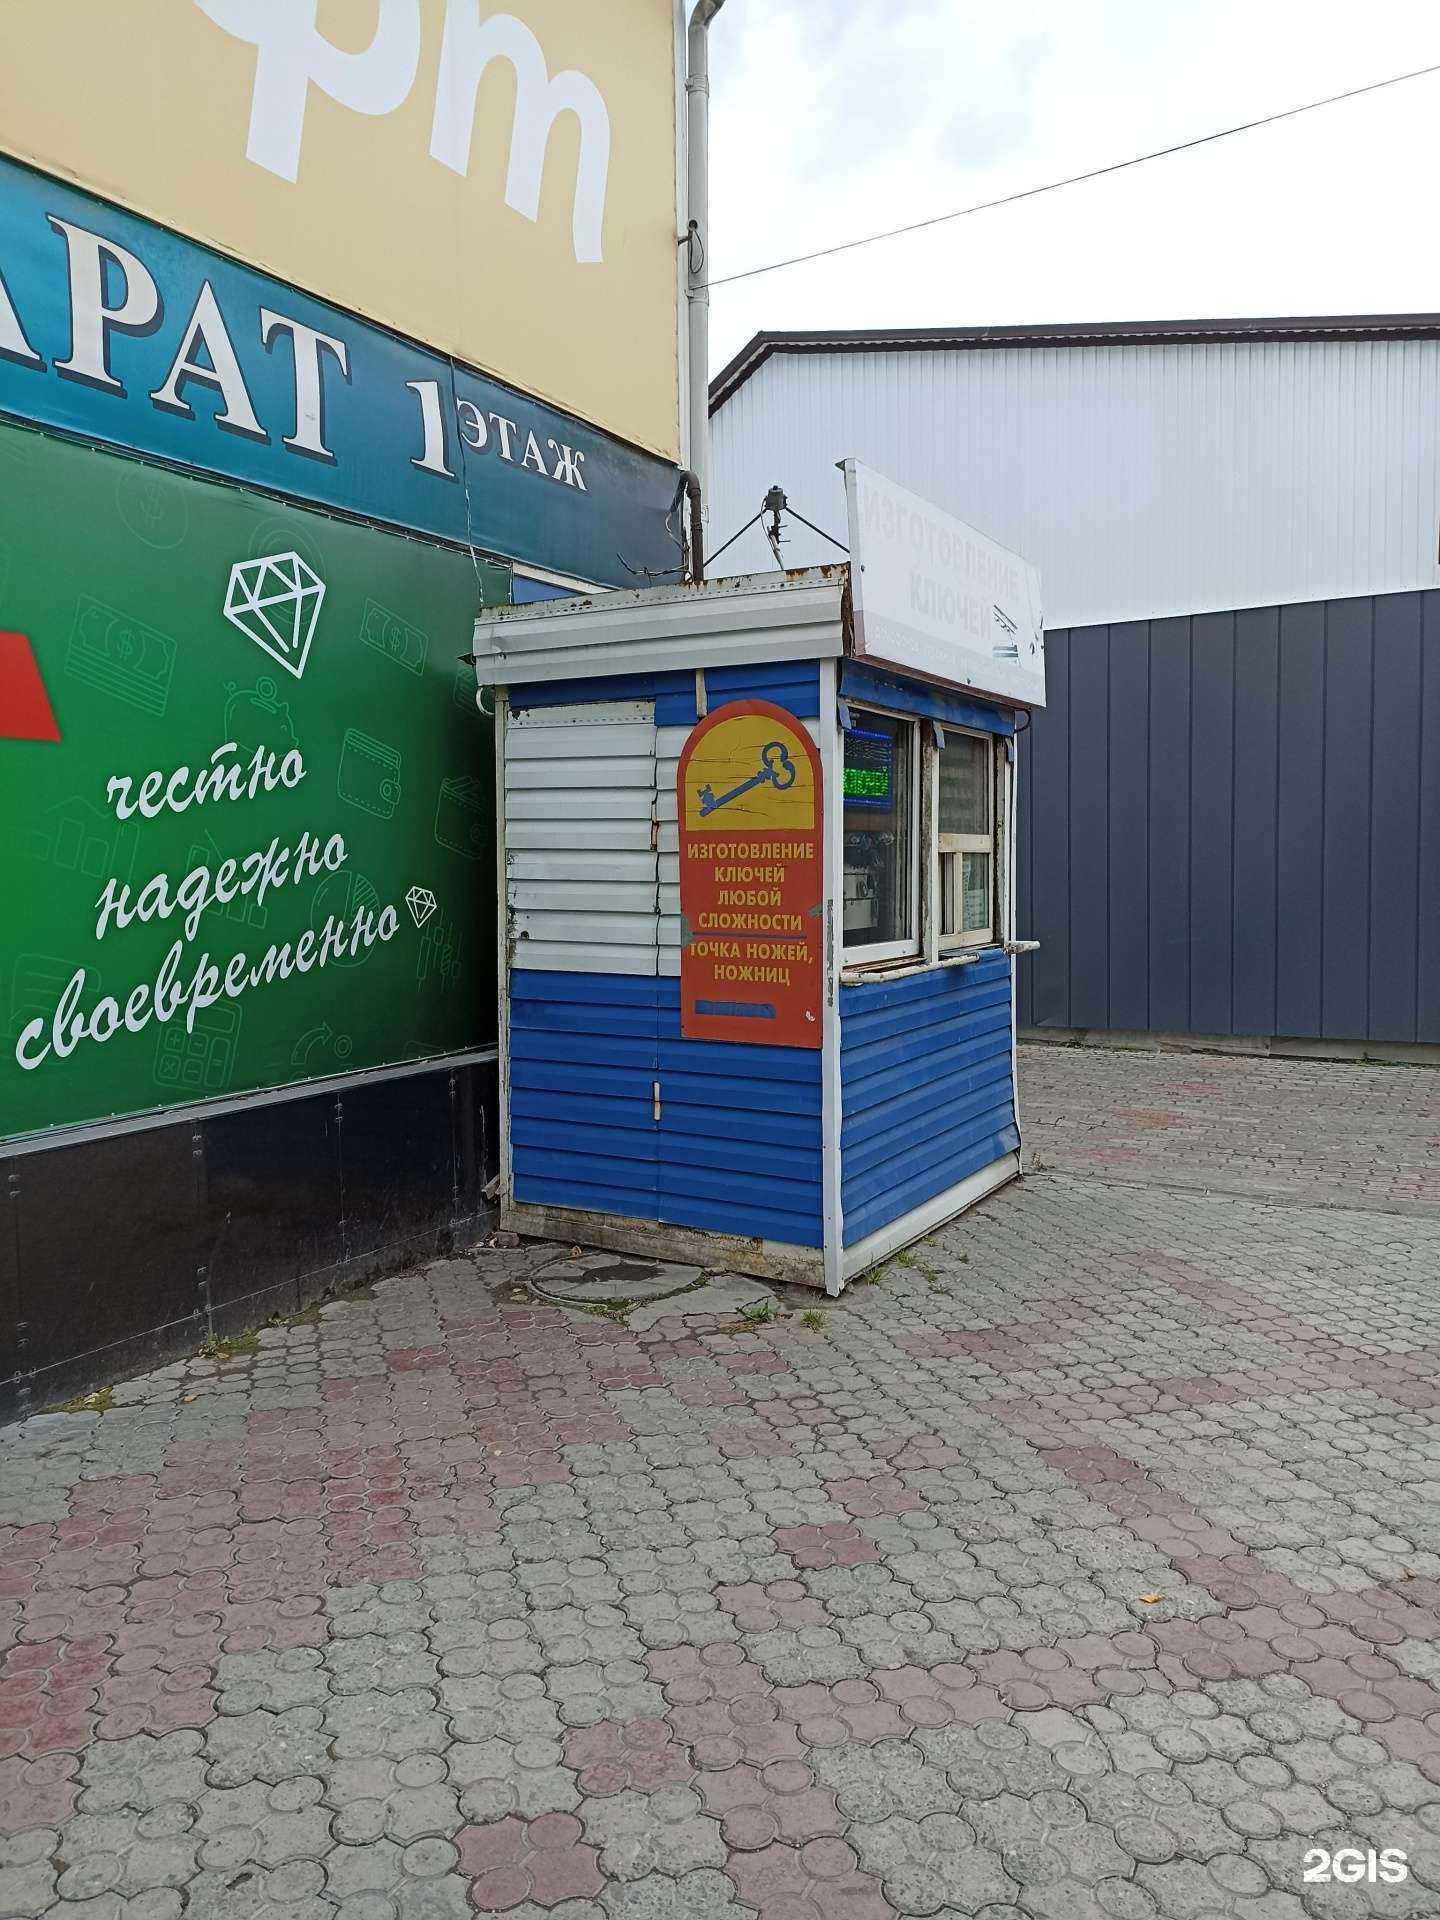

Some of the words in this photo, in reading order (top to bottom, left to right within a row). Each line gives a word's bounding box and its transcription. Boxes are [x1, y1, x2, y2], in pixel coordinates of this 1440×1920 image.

[406, 381, 455, 478] 1
[458, 400, 587, 490] ЭТАЖ
[106, 743, 307, 821] честно
[687, 843, 814, 859] ИЗГОТОВЛЕНИЕ
[715, 864, 785, 882] КЛЮЧЕЙ
[95, 831, 349, 941] надежно
[717, 887, 782, 906] ЛЮБОЙ
[698, 912, 802, 931] СЛОЖНОСТИ
[690, 943, 741, 958] ТОЧКА
[746, 940, 814, 964] НОЖЕЙ,
[714, 964, 790, 986] НОЖНИЦ
[14, 904, 401, 1072] своевременно
